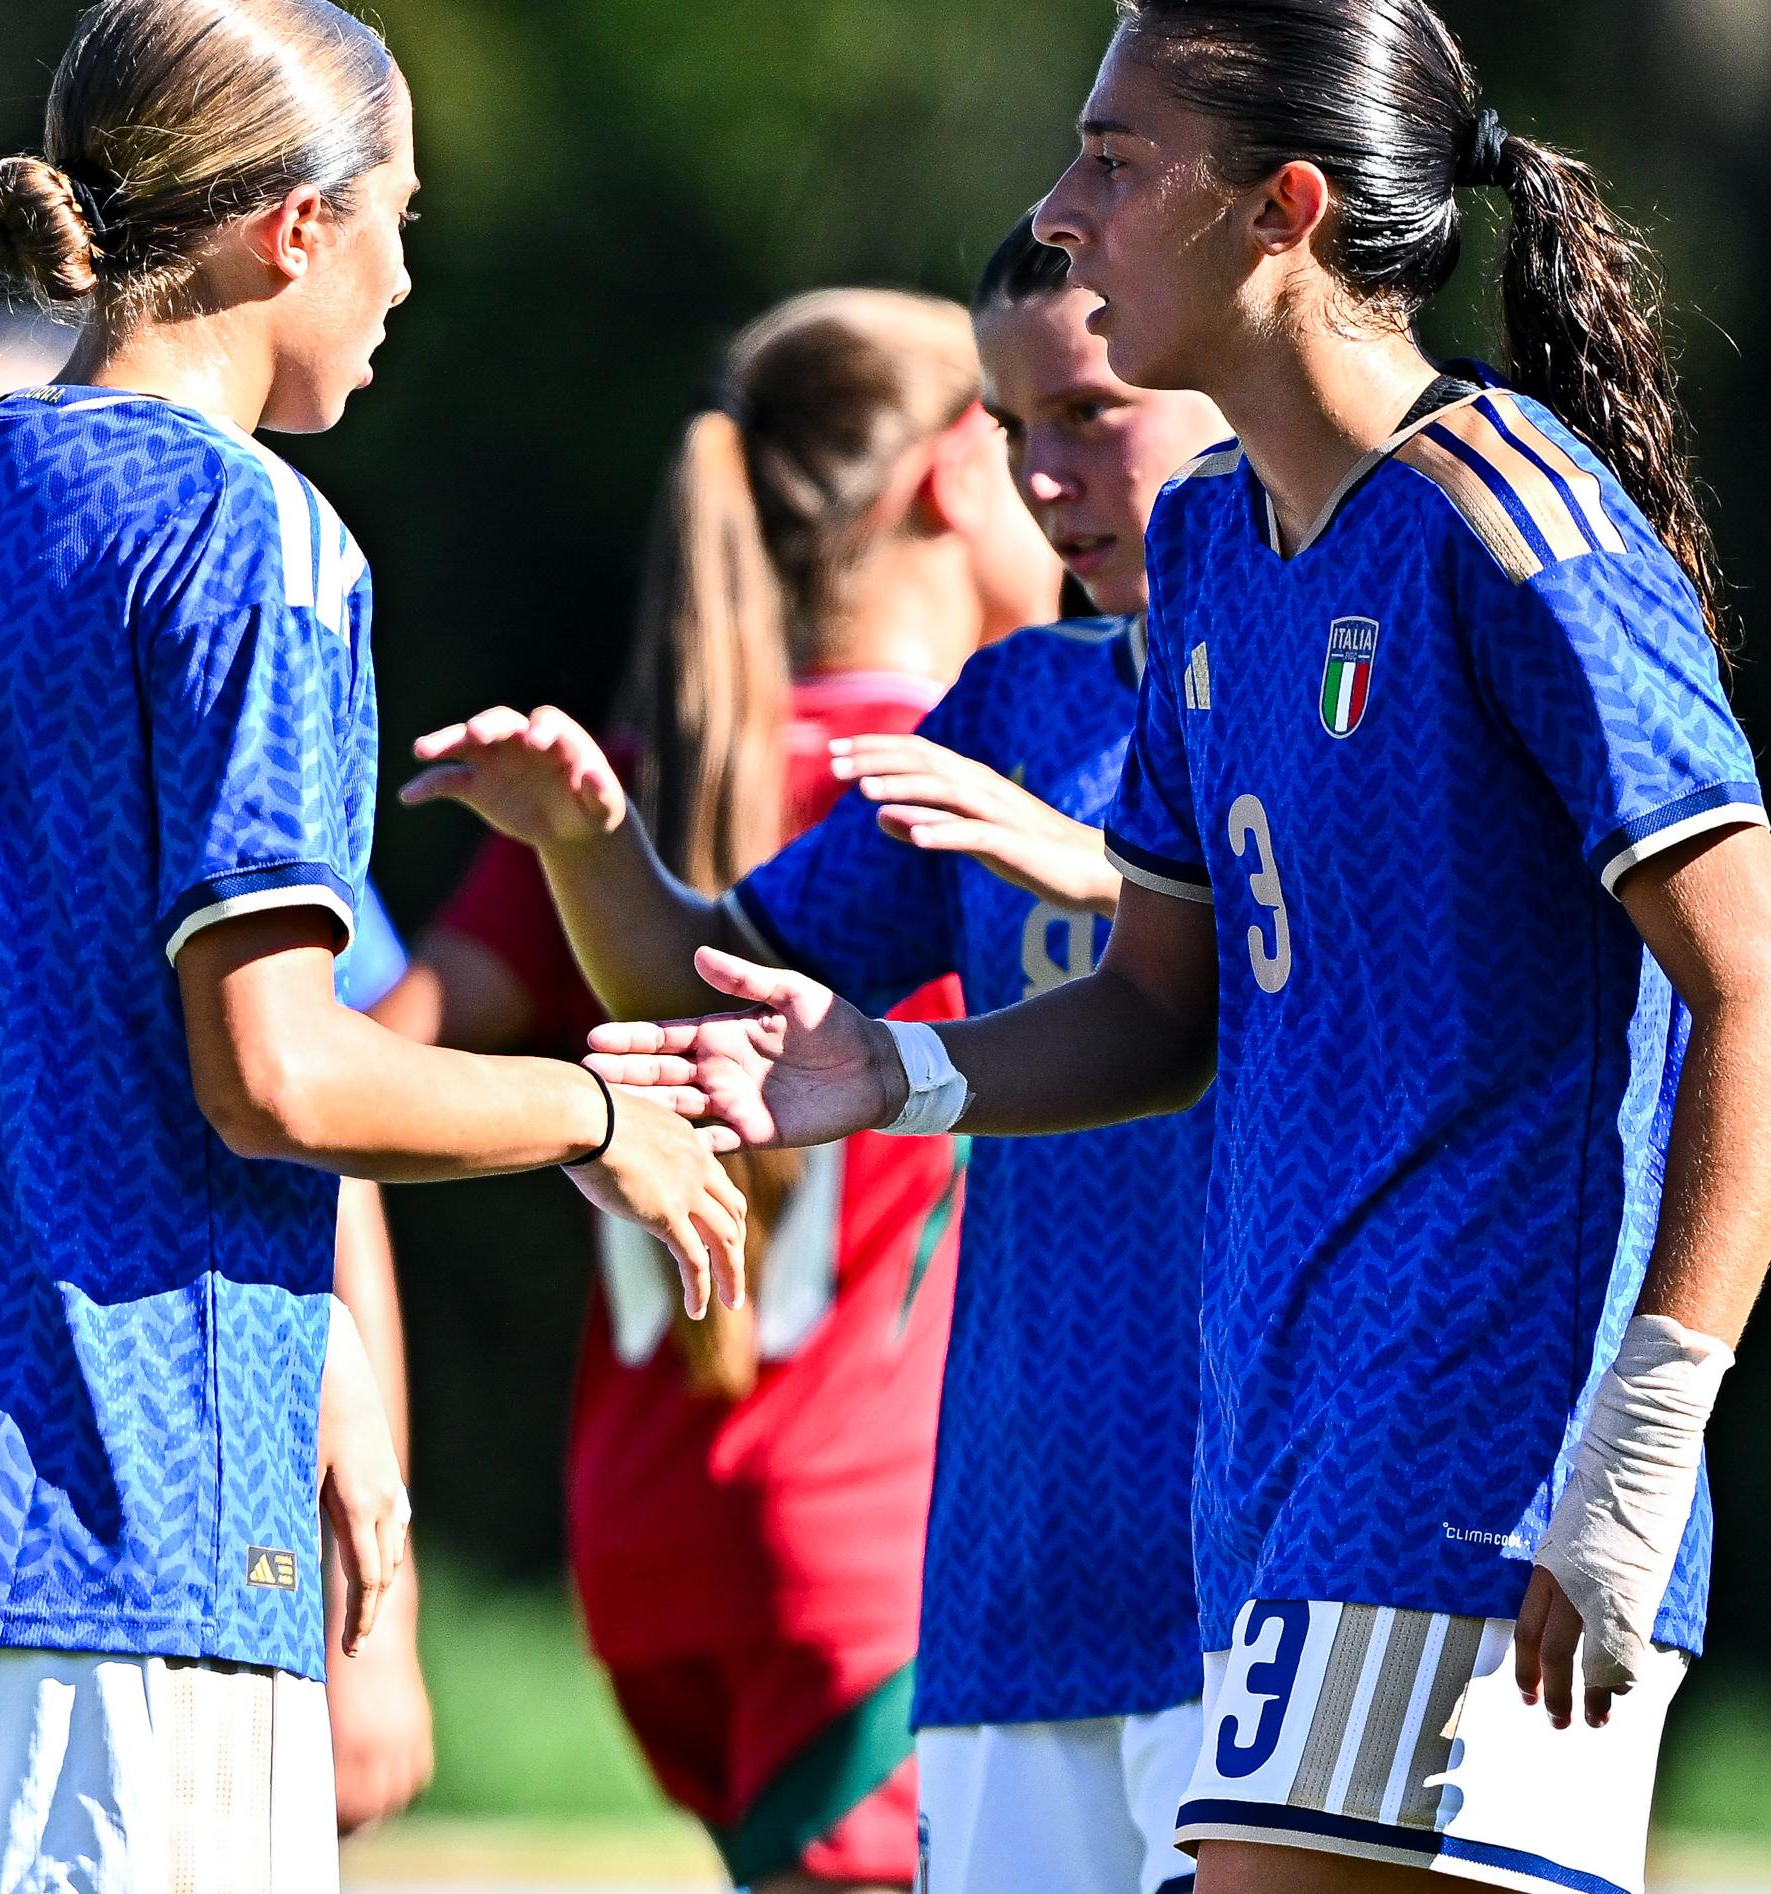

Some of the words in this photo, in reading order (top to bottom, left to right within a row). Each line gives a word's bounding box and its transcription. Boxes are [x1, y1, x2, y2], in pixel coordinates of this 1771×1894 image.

[1332, 628, 1372, 651] ITALIA
[1227, 793, 1292, 994] 3
[1214, 1599, 1311, 1779] 3
